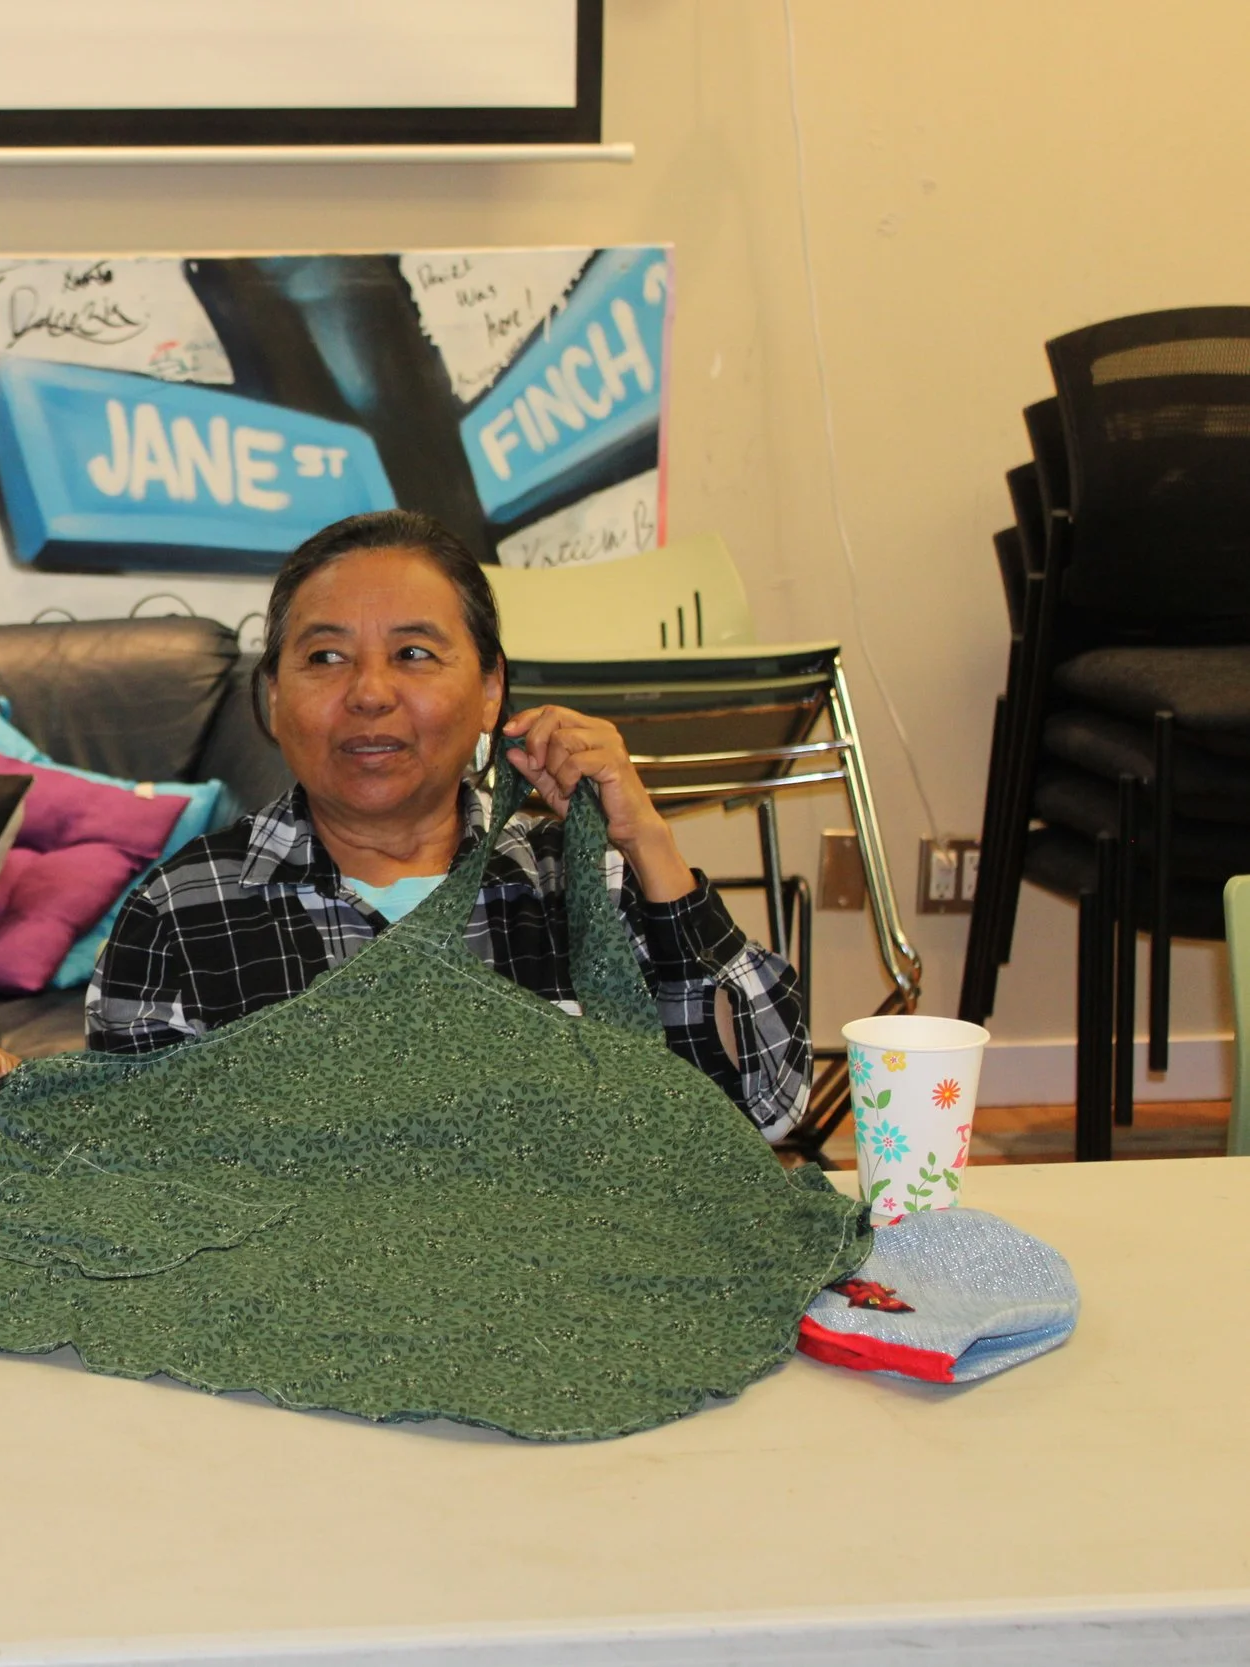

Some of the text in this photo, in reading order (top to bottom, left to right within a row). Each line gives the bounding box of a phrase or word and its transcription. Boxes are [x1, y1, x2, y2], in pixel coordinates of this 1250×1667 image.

[87, 398, 349, 511] JANE ST
[478, 297, 655, 482] FINCH
